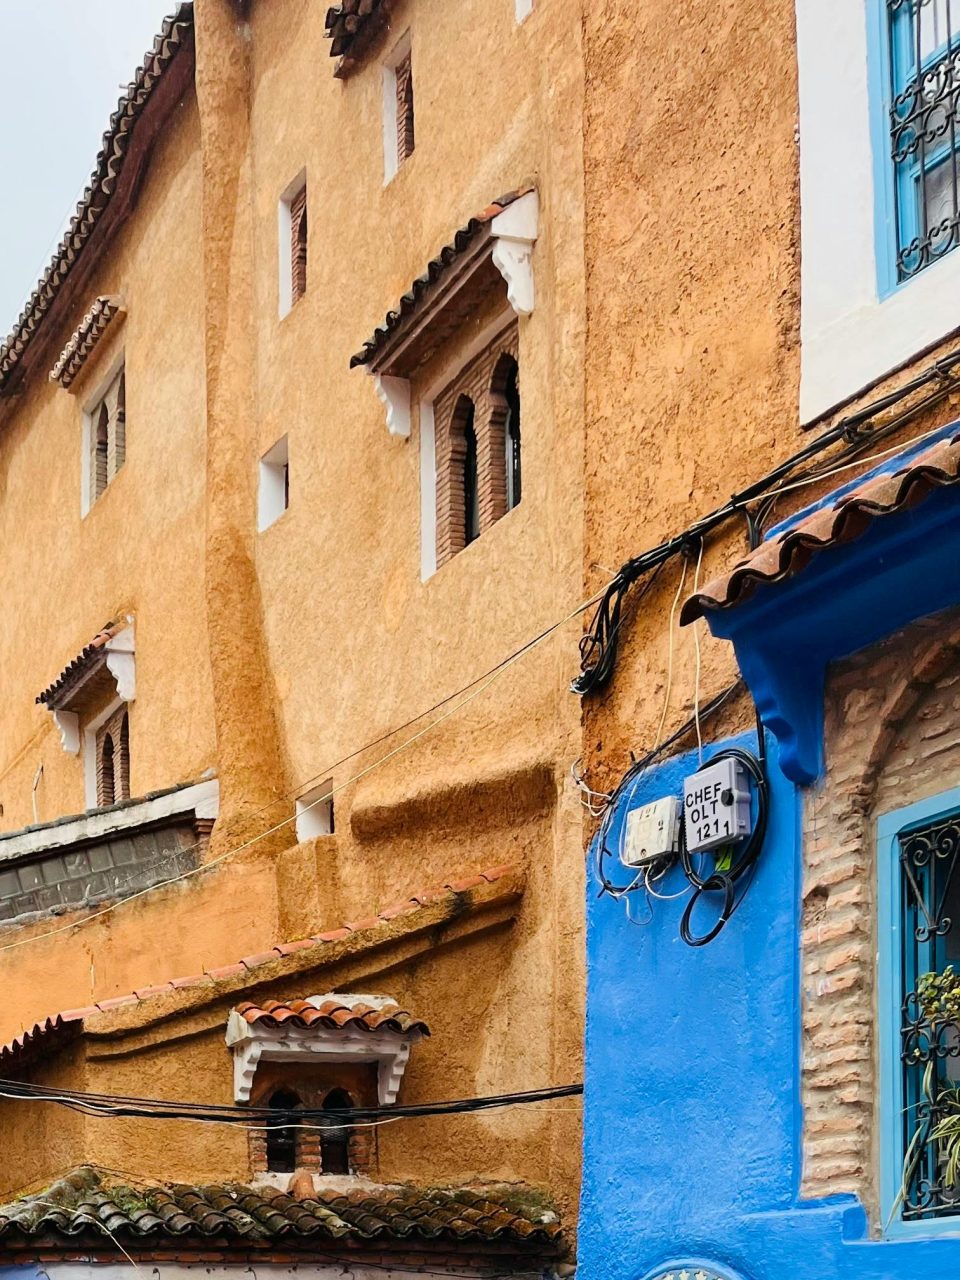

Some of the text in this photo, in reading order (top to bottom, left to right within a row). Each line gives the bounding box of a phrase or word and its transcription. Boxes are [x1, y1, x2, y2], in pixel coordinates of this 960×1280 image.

[685, 782, 722, 808] CHEF
[690, 799, 719, 824] OLT
[696, 818, 730, 842] 1211
